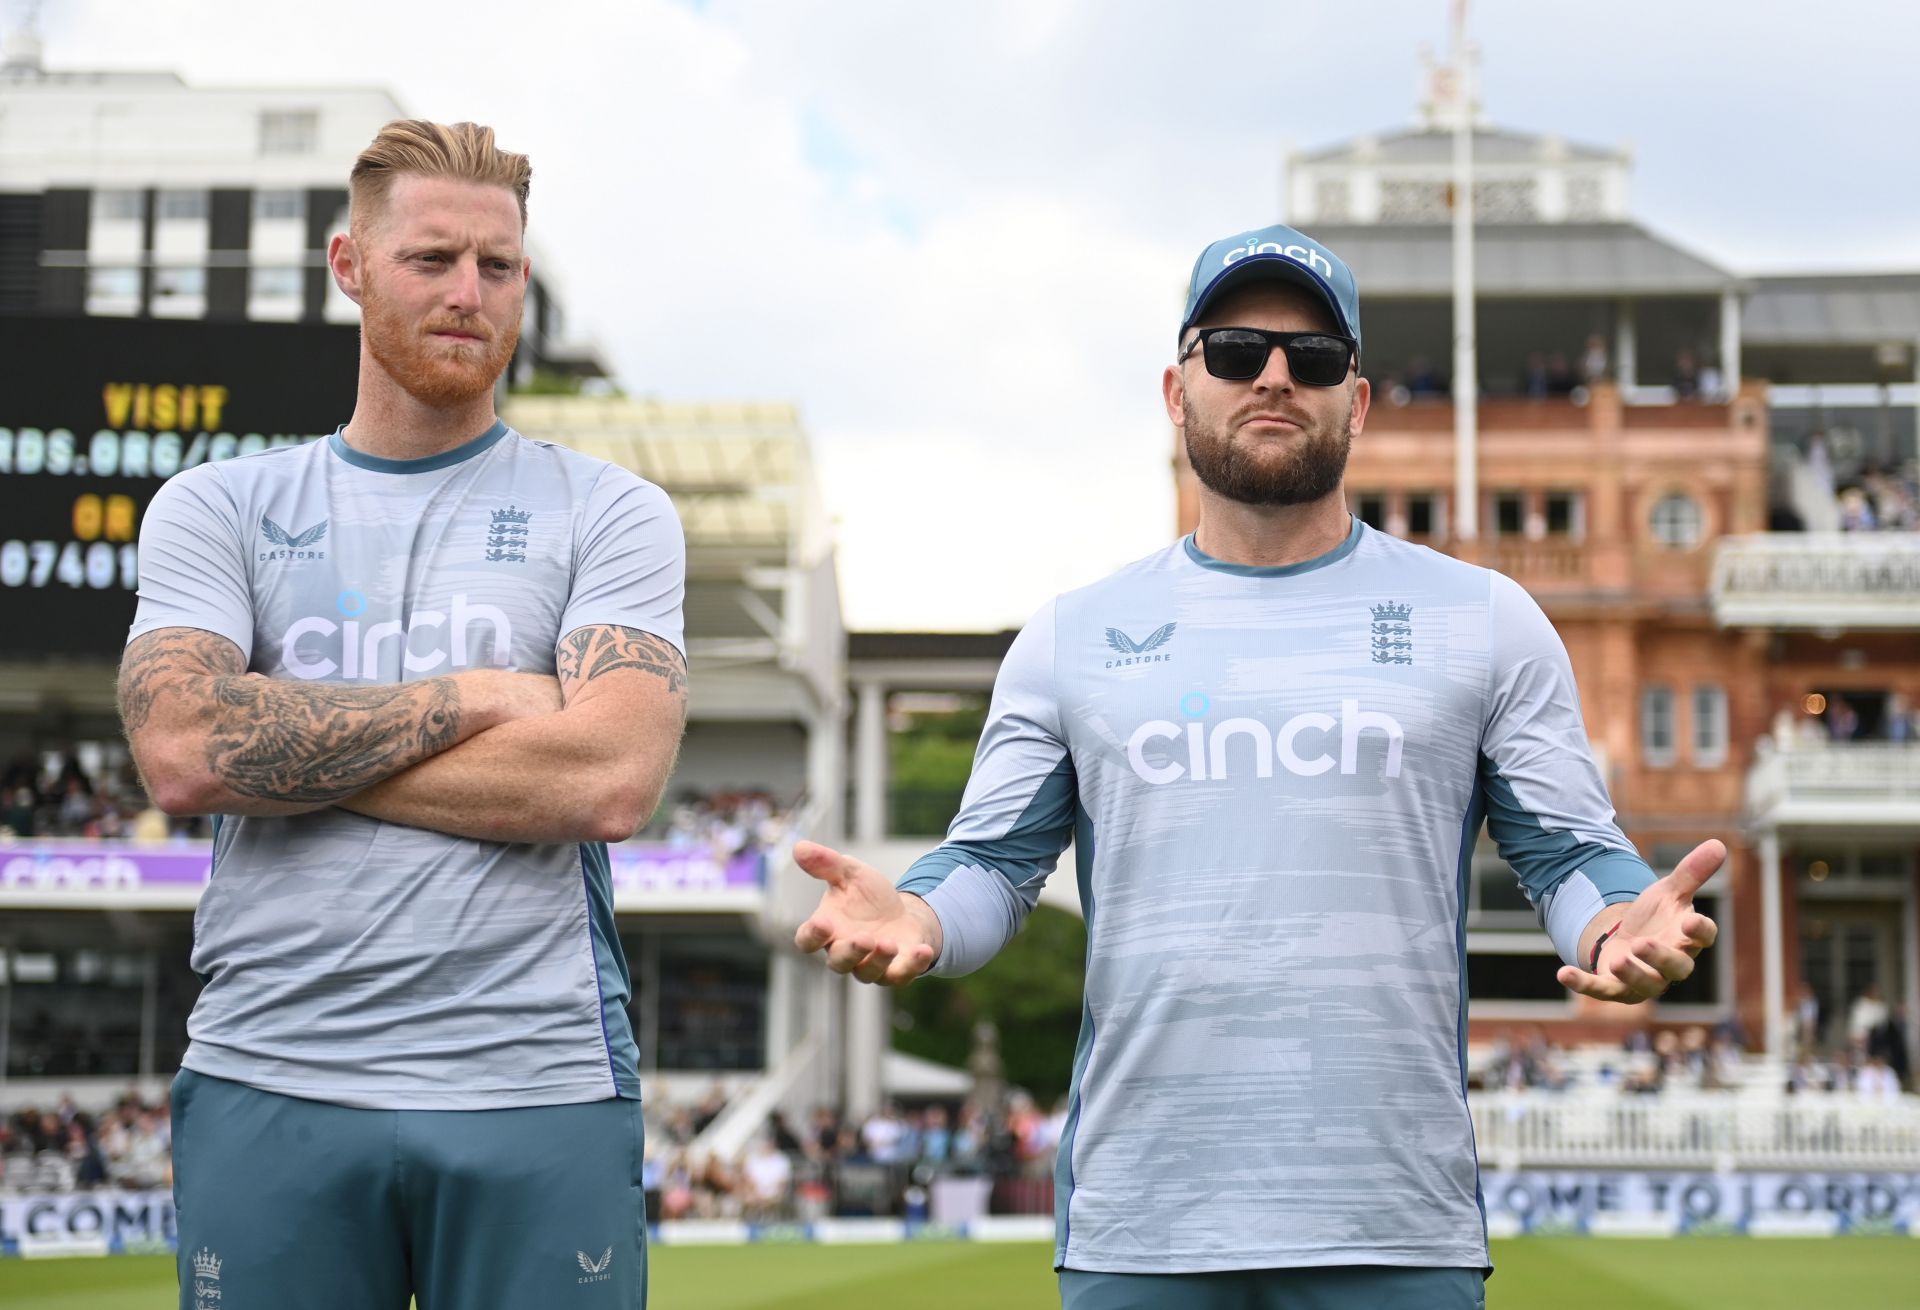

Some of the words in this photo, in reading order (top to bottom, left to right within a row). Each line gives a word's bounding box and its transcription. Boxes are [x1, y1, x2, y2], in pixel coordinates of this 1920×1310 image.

[1223, 238, 1332, 278] cinch
[104, 383, 228, 431] VISIT
[73, 494, 136, 541] OR
[259, 550, 325, 562] CASTORE
[1105, 653, 1172, 669] CASTORE
[1127, 691, 1404, 785] cinch
[1647, 1179, 1719, 1219] TO
